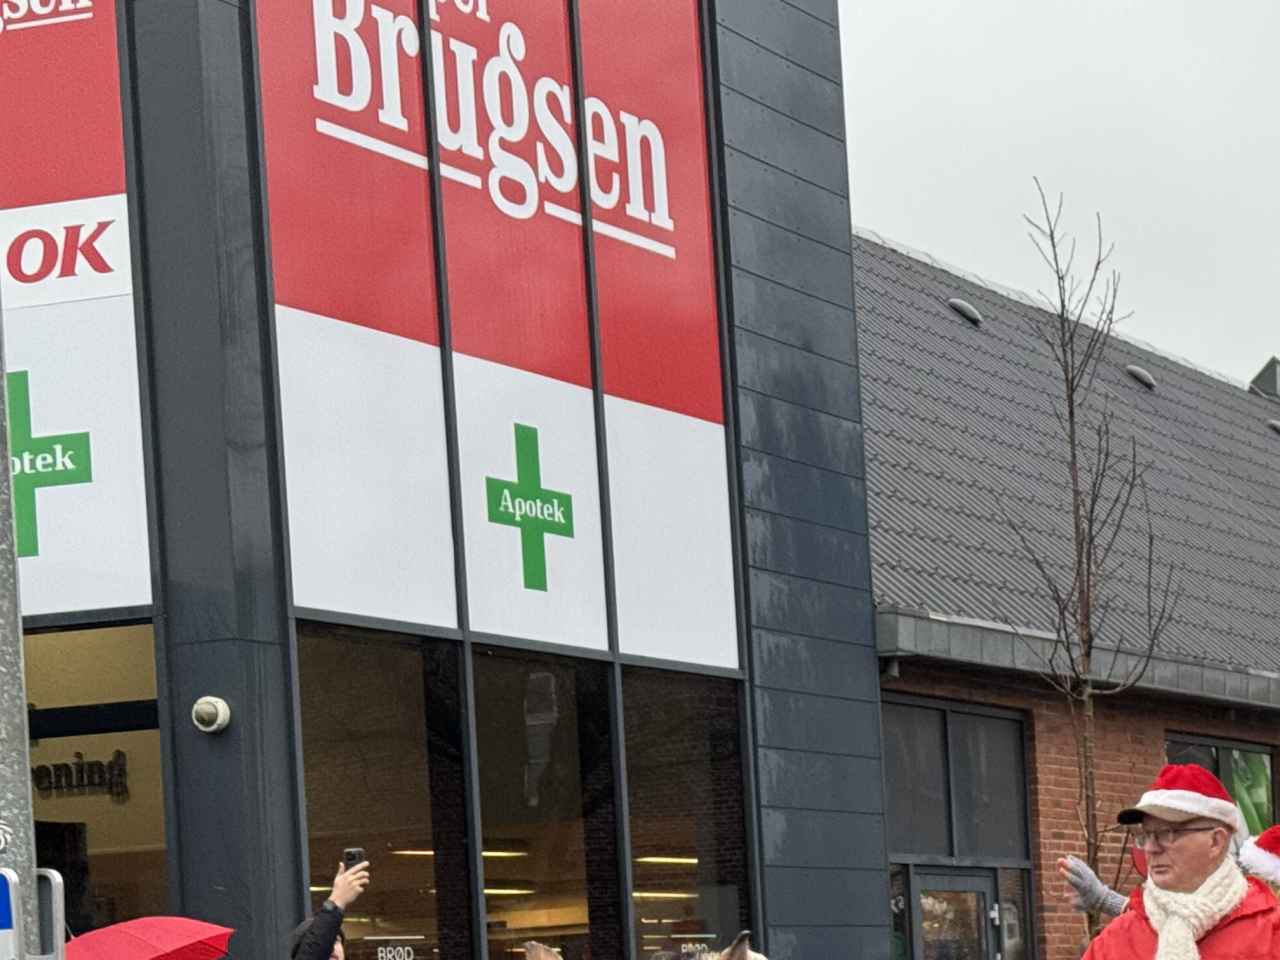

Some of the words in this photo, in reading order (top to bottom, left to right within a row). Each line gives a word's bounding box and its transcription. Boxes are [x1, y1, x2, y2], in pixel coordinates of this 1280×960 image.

[313, 0, 675, 231] Brugsen
[6, 219, 116, 284] OK
[10, 444, 77, 476] otek
[499, 488, 566, 525] Apotek
[32, 749, 130, 804] ening
